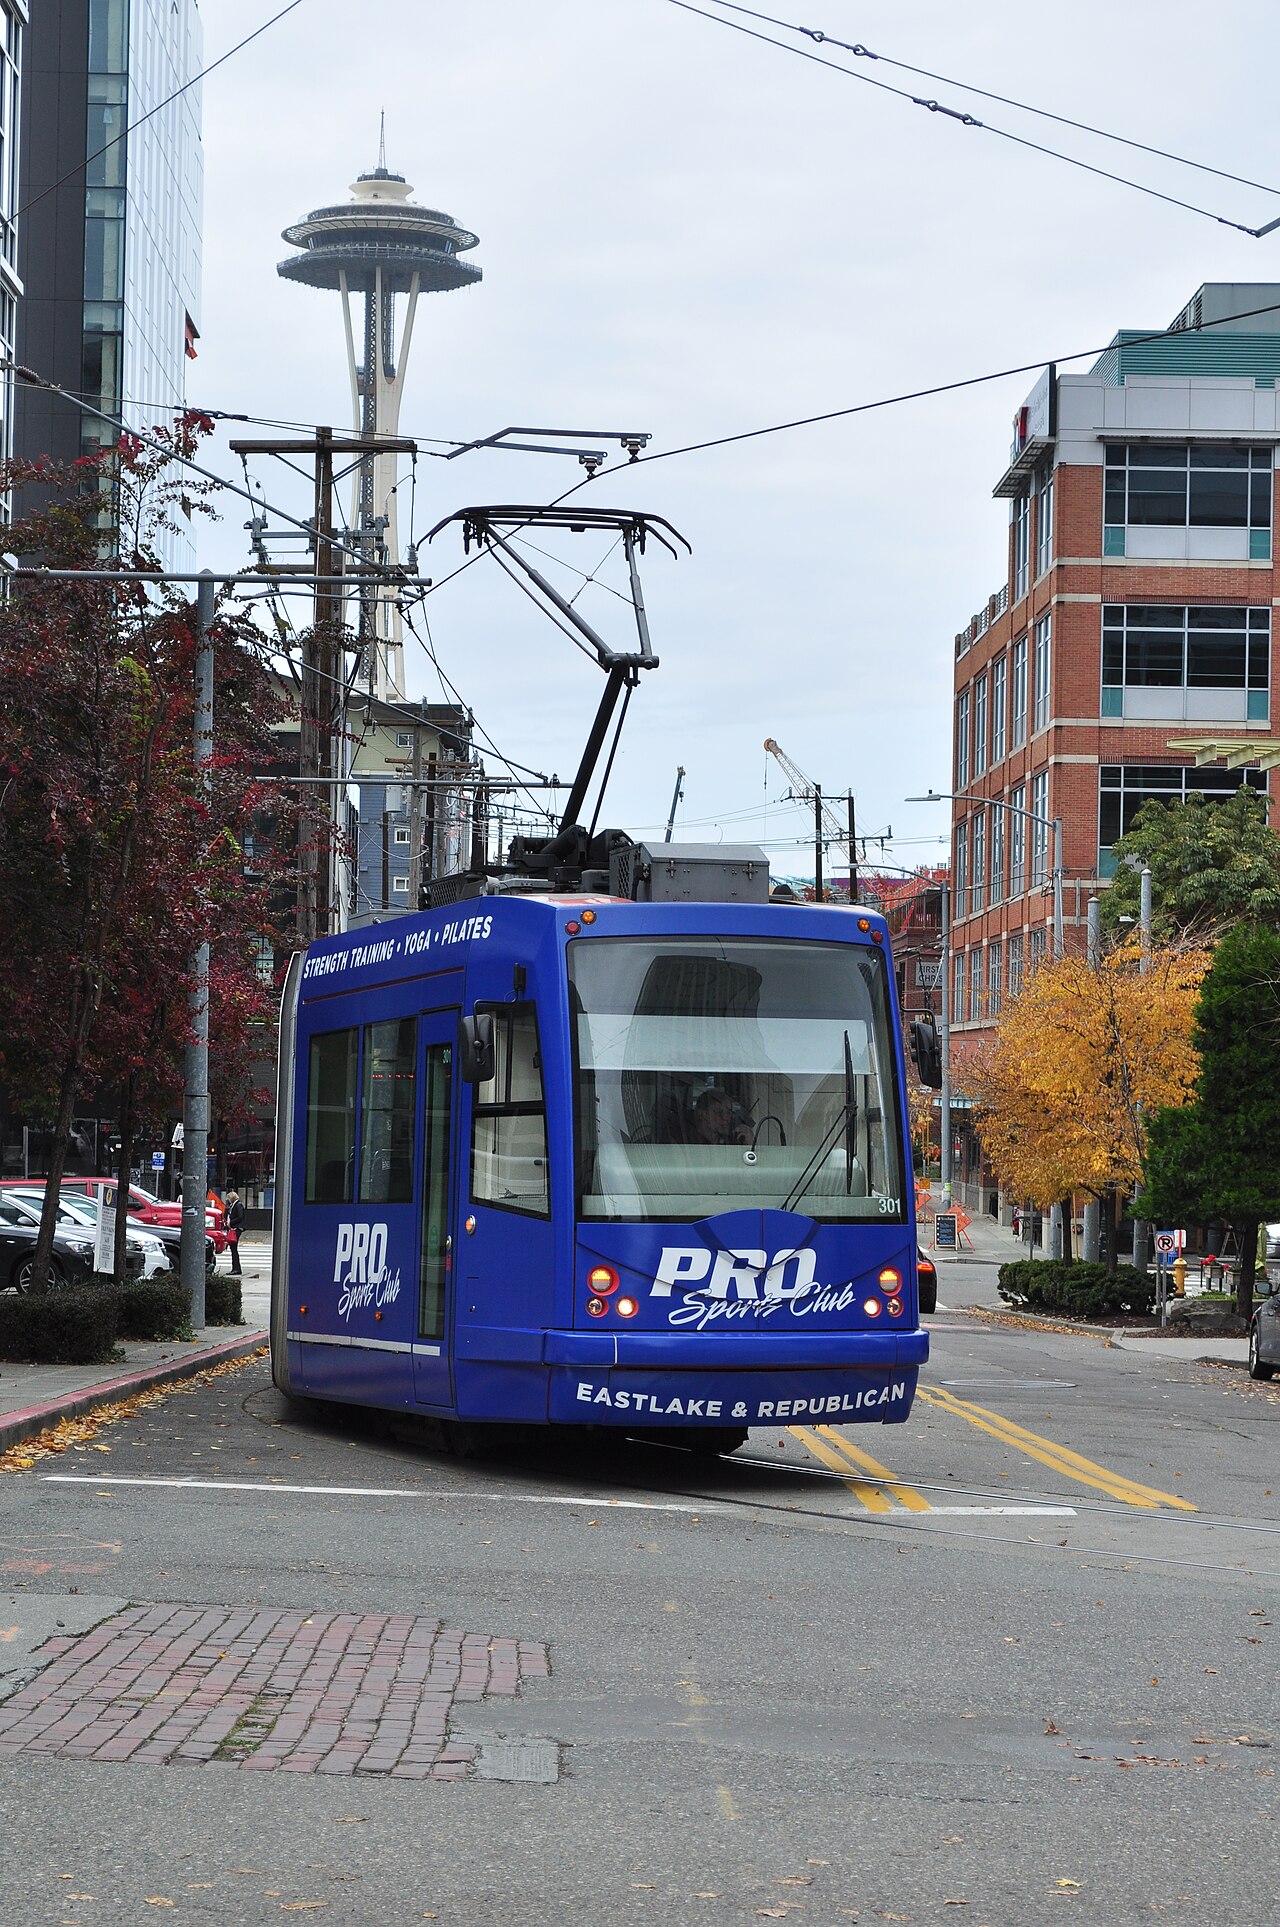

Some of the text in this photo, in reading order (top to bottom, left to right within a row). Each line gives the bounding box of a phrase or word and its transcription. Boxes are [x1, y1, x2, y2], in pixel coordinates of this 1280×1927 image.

[303, 915, 493, 979] STRENGTH TRAINING YOGA PILATES
[878, 1198, 901, 1214] 301
[333, 1223, 388, 1283] PRO
[649, 1247, 817, 1299] PRO
[338, 1265, 401, 1323] Sports Club
[668, 1281, 856, 1331] Sports Club
[576, 1382, 906, 1418] EASTLAKE & REPUBLICAN
